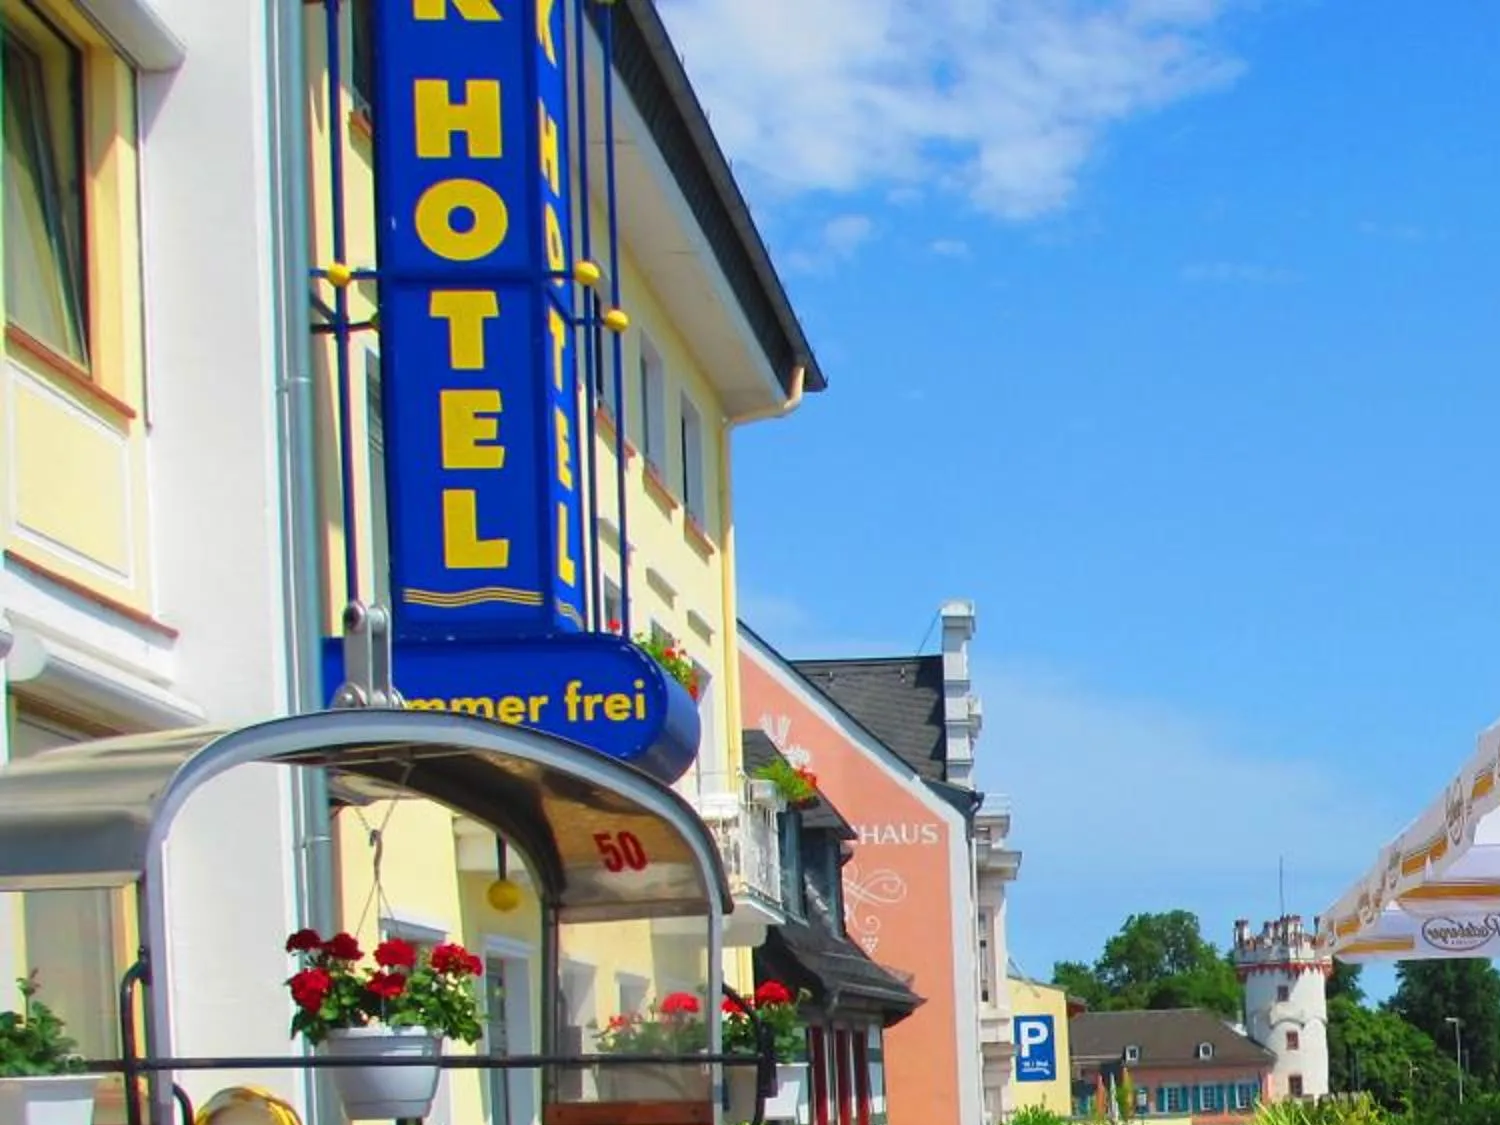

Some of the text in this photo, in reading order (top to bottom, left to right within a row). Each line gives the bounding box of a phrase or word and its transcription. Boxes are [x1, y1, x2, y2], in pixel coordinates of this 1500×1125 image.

[414, 78, 508, 569] HOTEL
[565, 678, 646, 721] frei
[593, 831, 648, 872] 50
[852, 823, 939, 845] HAUS
[1021, 1022, 1048, 1058] P
